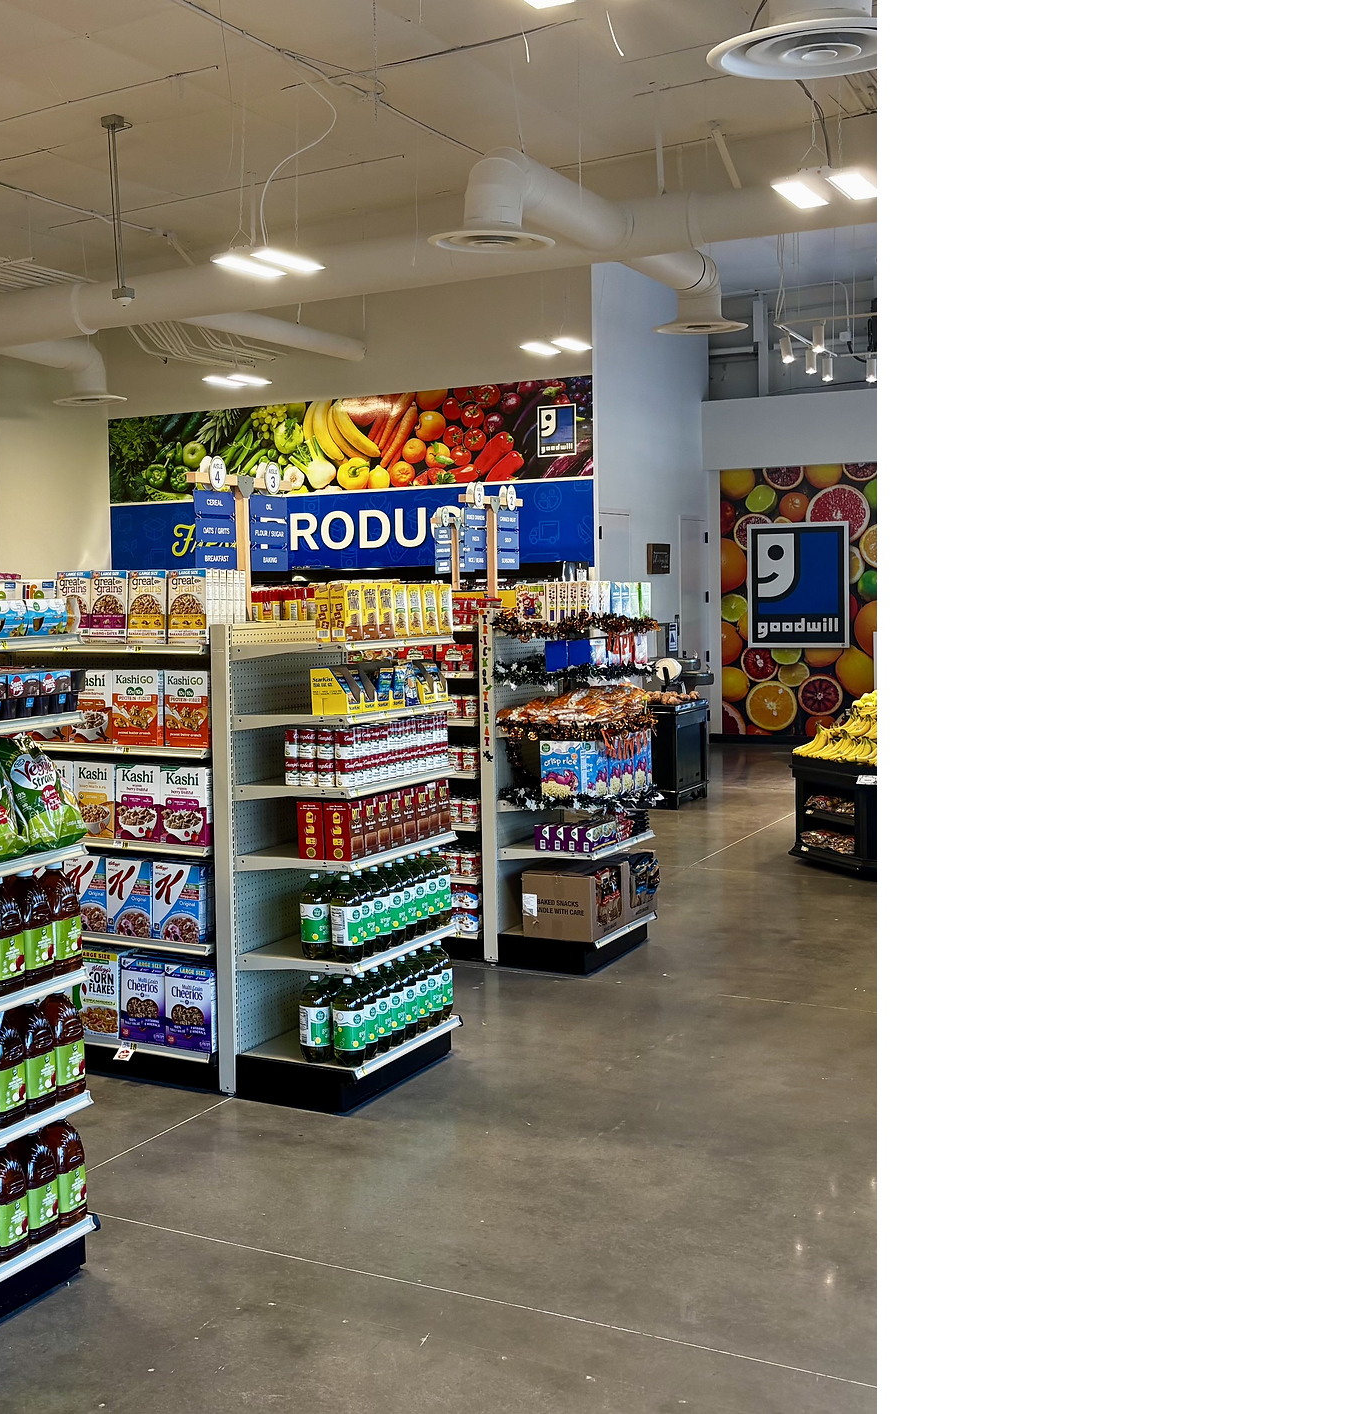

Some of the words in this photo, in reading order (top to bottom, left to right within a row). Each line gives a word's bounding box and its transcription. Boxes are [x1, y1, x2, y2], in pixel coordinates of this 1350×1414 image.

[541, 443, 573, 454] goodwill
[215, 471, 221, 484] 4
[270, 476, 276, 488] 3
[206, 499, 223, 507] CEREAL
[255, 529, 268, 537] FLOUR
[271, 530, 284, 538] SUGAR
[258, 505, 462, 553] RODU
[59, 576, 80, 588] great
[93, 576, 114, 588] great
[131, 577, 154, 589] great
[171, 576, 194, 589] great
[61, 584, 87, 596] grains
[96, 585, 122, 596] grains
[135, 585, 162, 595] grains
[175, 584, 202, 595] grains
[757, 618, 838, 639] goodwill
[84, 674, 106, 687] ashi
[544, 757, 561, 766] crisp
[563, 756, 578, 765] rice
[78, 767, 107, 780] Kashi
[122, 769, 153, 783] Kashi
[166, 772, 199, 786] Kashi
[108, 865, 135, 900] K
[155, 870, 184, 905] K
[89, 972, 114, 985] CORN
[89, 982, 115, 995] FLAKES
[127, 979, 159, 993] Cheerios
[171, 986, 203, 1001] Cheerios
